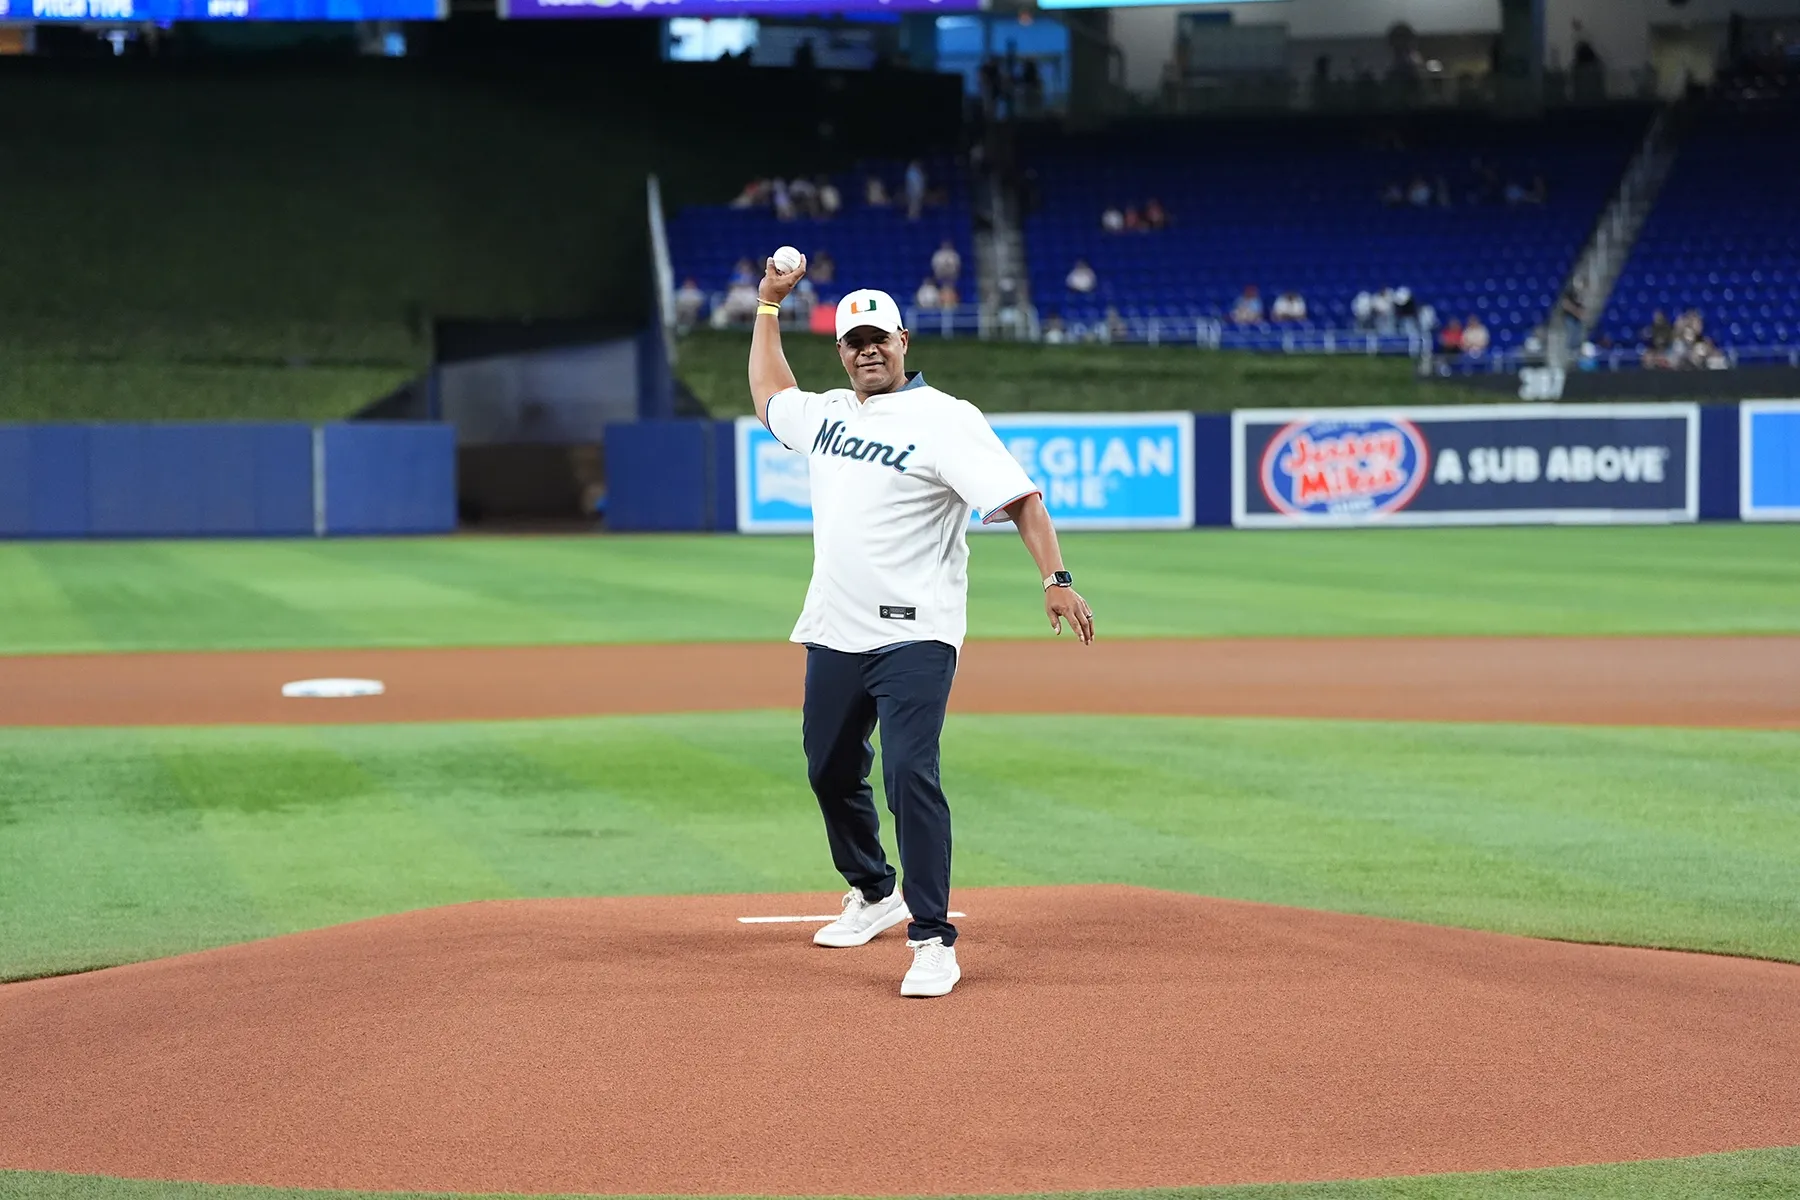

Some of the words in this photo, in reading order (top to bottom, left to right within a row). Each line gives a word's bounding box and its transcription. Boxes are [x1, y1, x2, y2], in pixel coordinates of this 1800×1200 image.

[810, 418, 916, 472] Miami
[1284, 434, 1402, 470] Jersey
[1434, 448, 1464, 485] A
[1468, 447, 1540, 484] SUB
[1546, 445, 1667, 483] ABOVE
